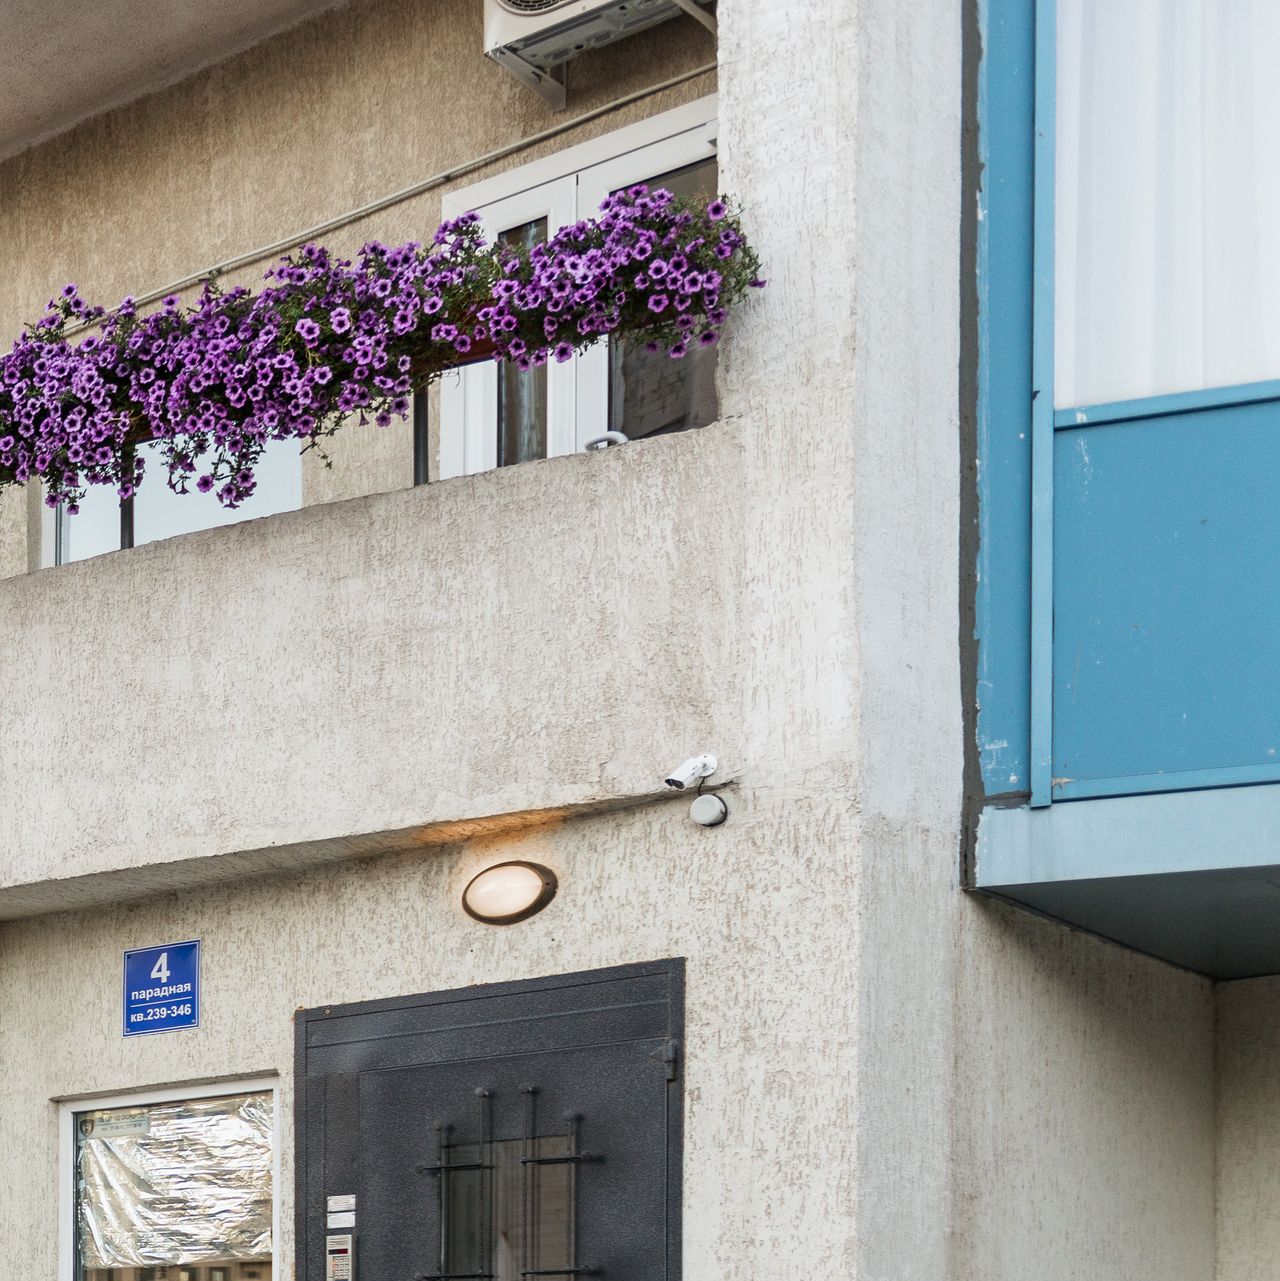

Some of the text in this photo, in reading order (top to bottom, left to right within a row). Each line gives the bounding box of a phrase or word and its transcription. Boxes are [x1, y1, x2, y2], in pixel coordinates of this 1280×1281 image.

[150, 952, 171, 983] 4
[131, 983, 192, 1001] парадная
[130, 1003, 193, 1023] кв.239-346
